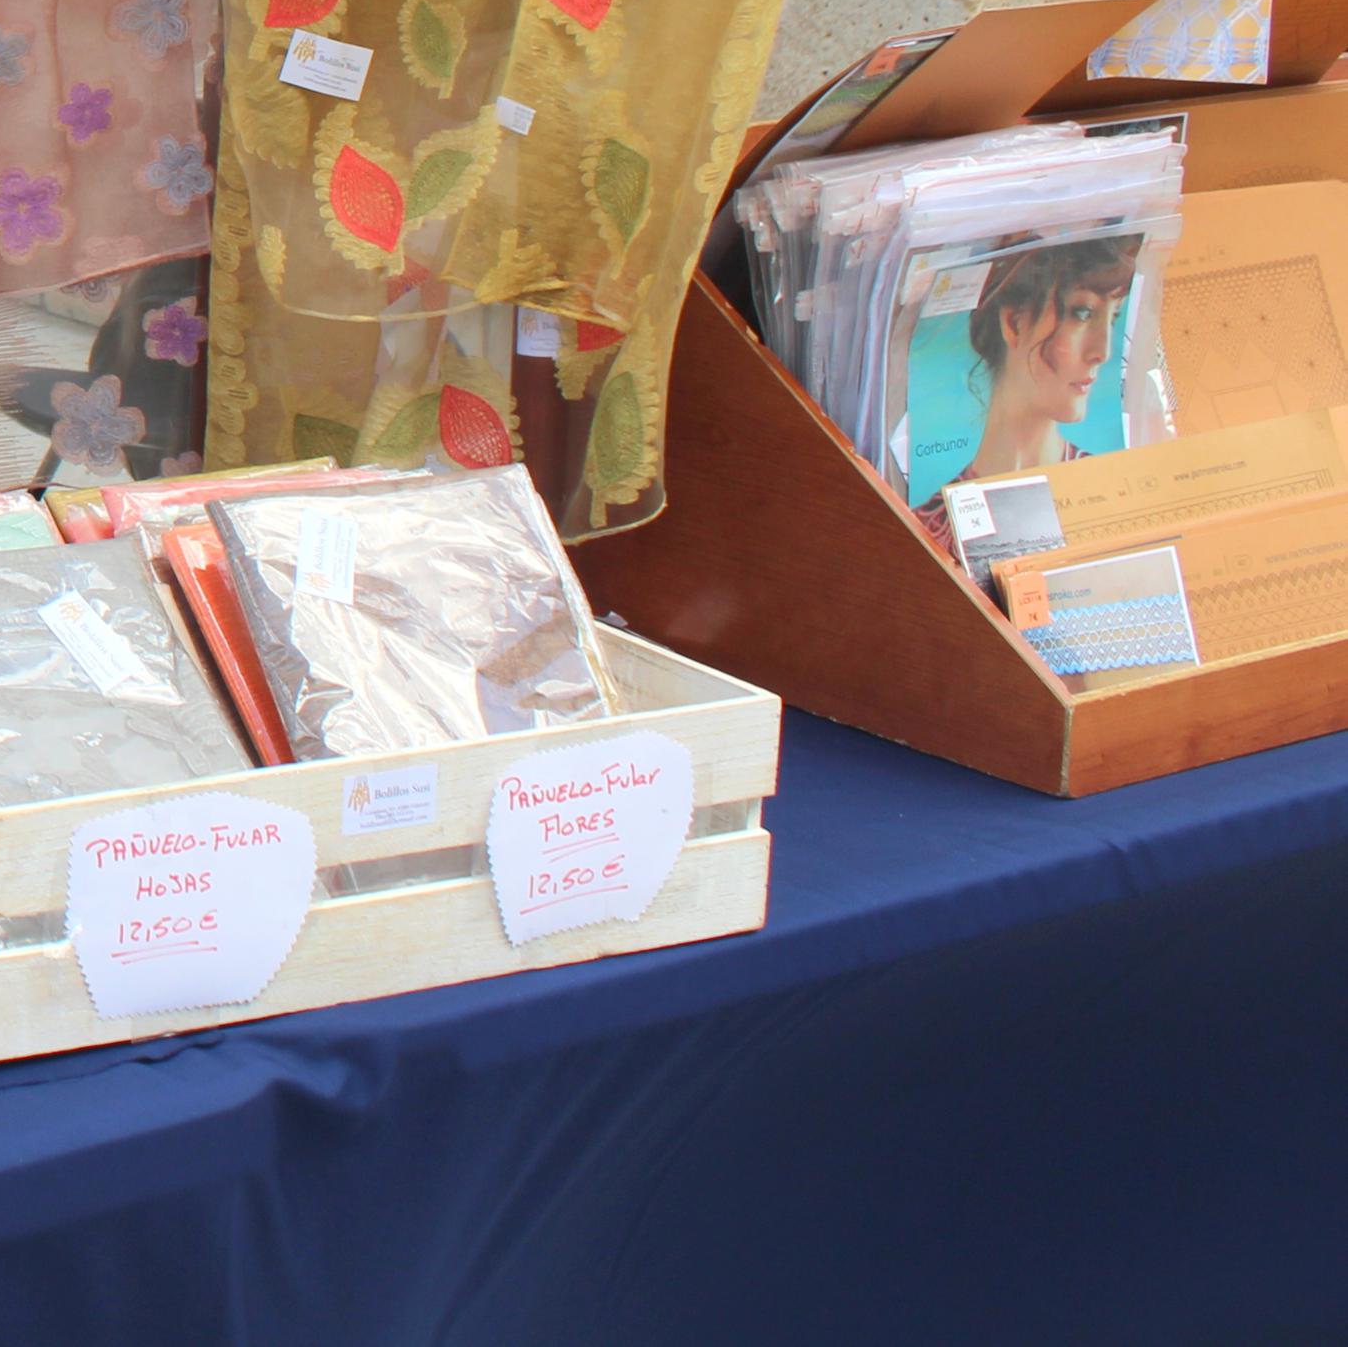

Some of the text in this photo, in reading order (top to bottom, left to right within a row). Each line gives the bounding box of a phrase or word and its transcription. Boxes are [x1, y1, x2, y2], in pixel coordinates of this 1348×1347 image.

[375, 781, 430, 799] Bolillos Susi
[85, 824, 282, 868] PAÑUELO-FULAR
